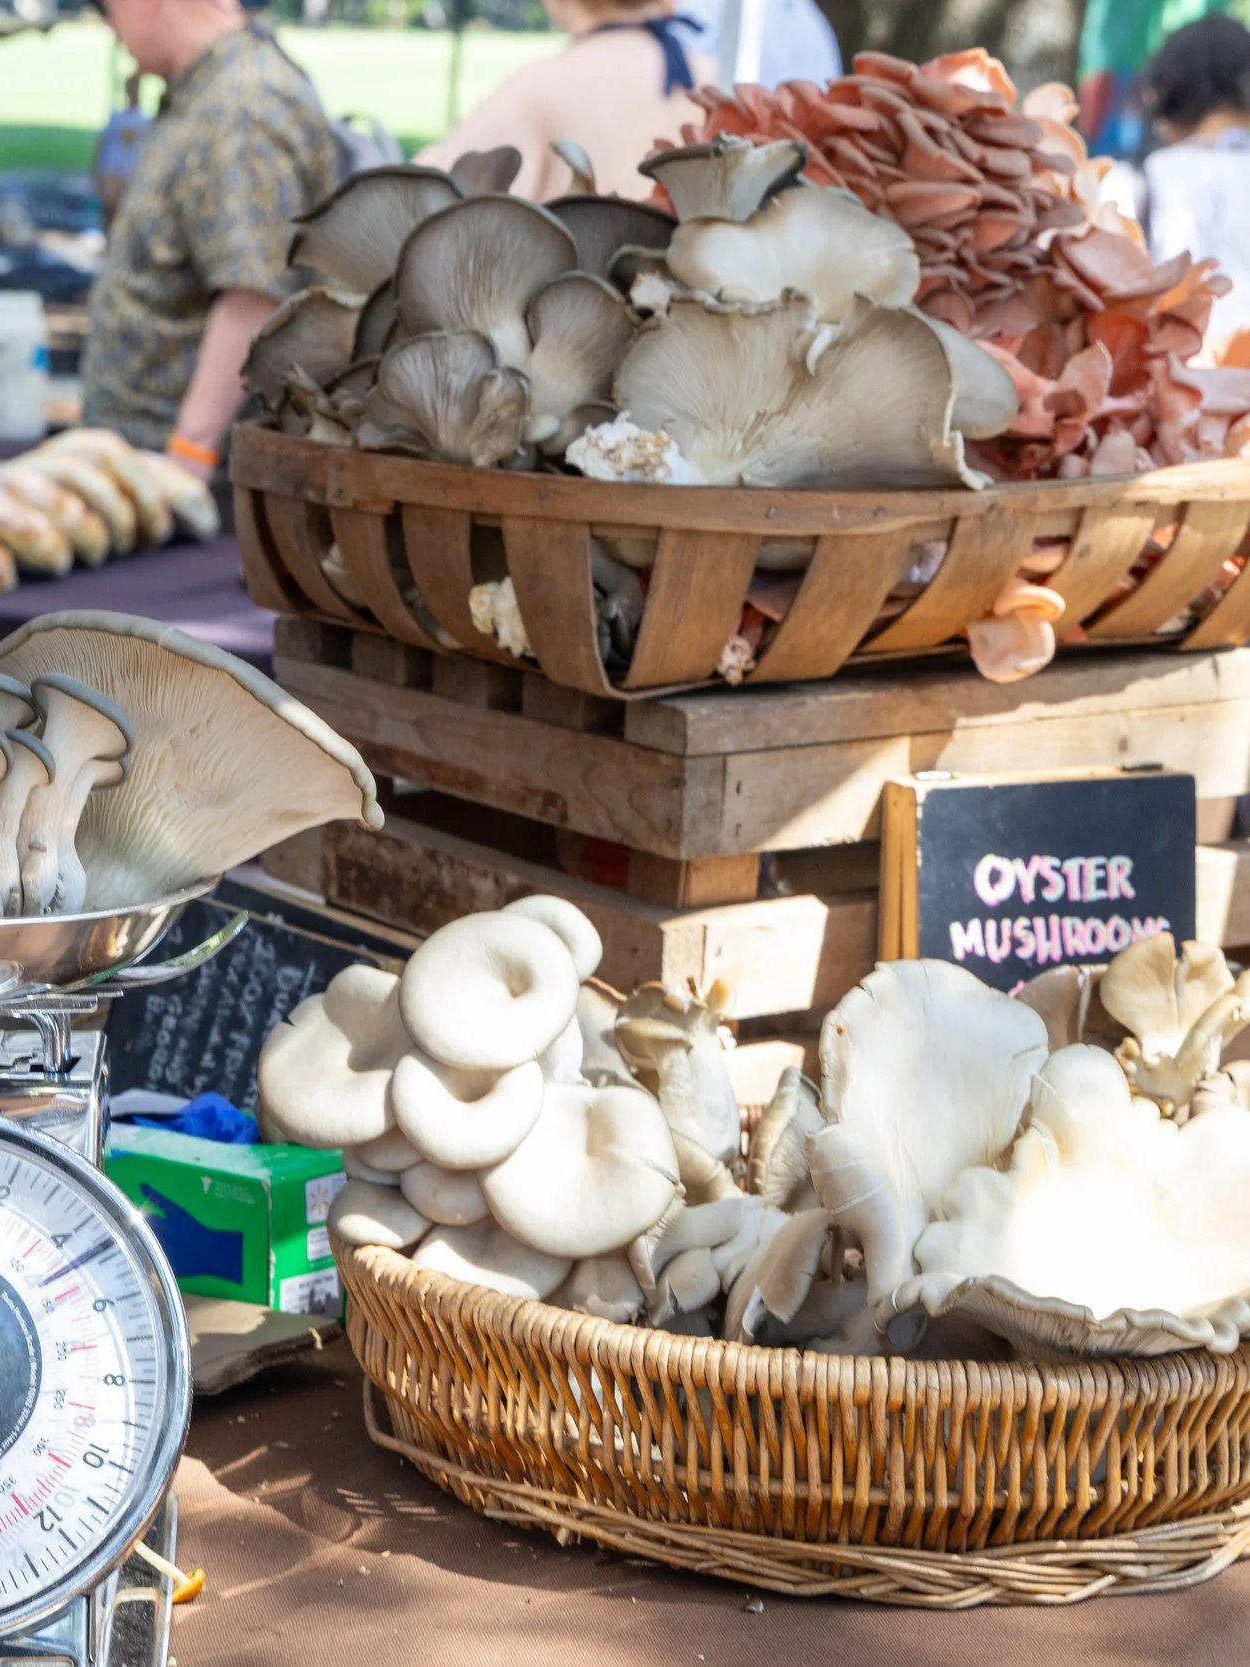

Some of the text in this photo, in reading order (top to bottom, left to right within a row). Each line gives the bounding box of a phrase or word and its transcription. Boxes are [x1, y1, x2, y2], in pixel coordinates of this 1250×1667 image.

[974, 853, 1136, 907] OYSTER
[51, 1232, 72, 1249] 4
[92, 1298, 115, 1313] 6
[103, 1374, 126, 1387] 8
[82, 1443, 110, 1469] 10
[32, 1505, 63, 1532] 12
